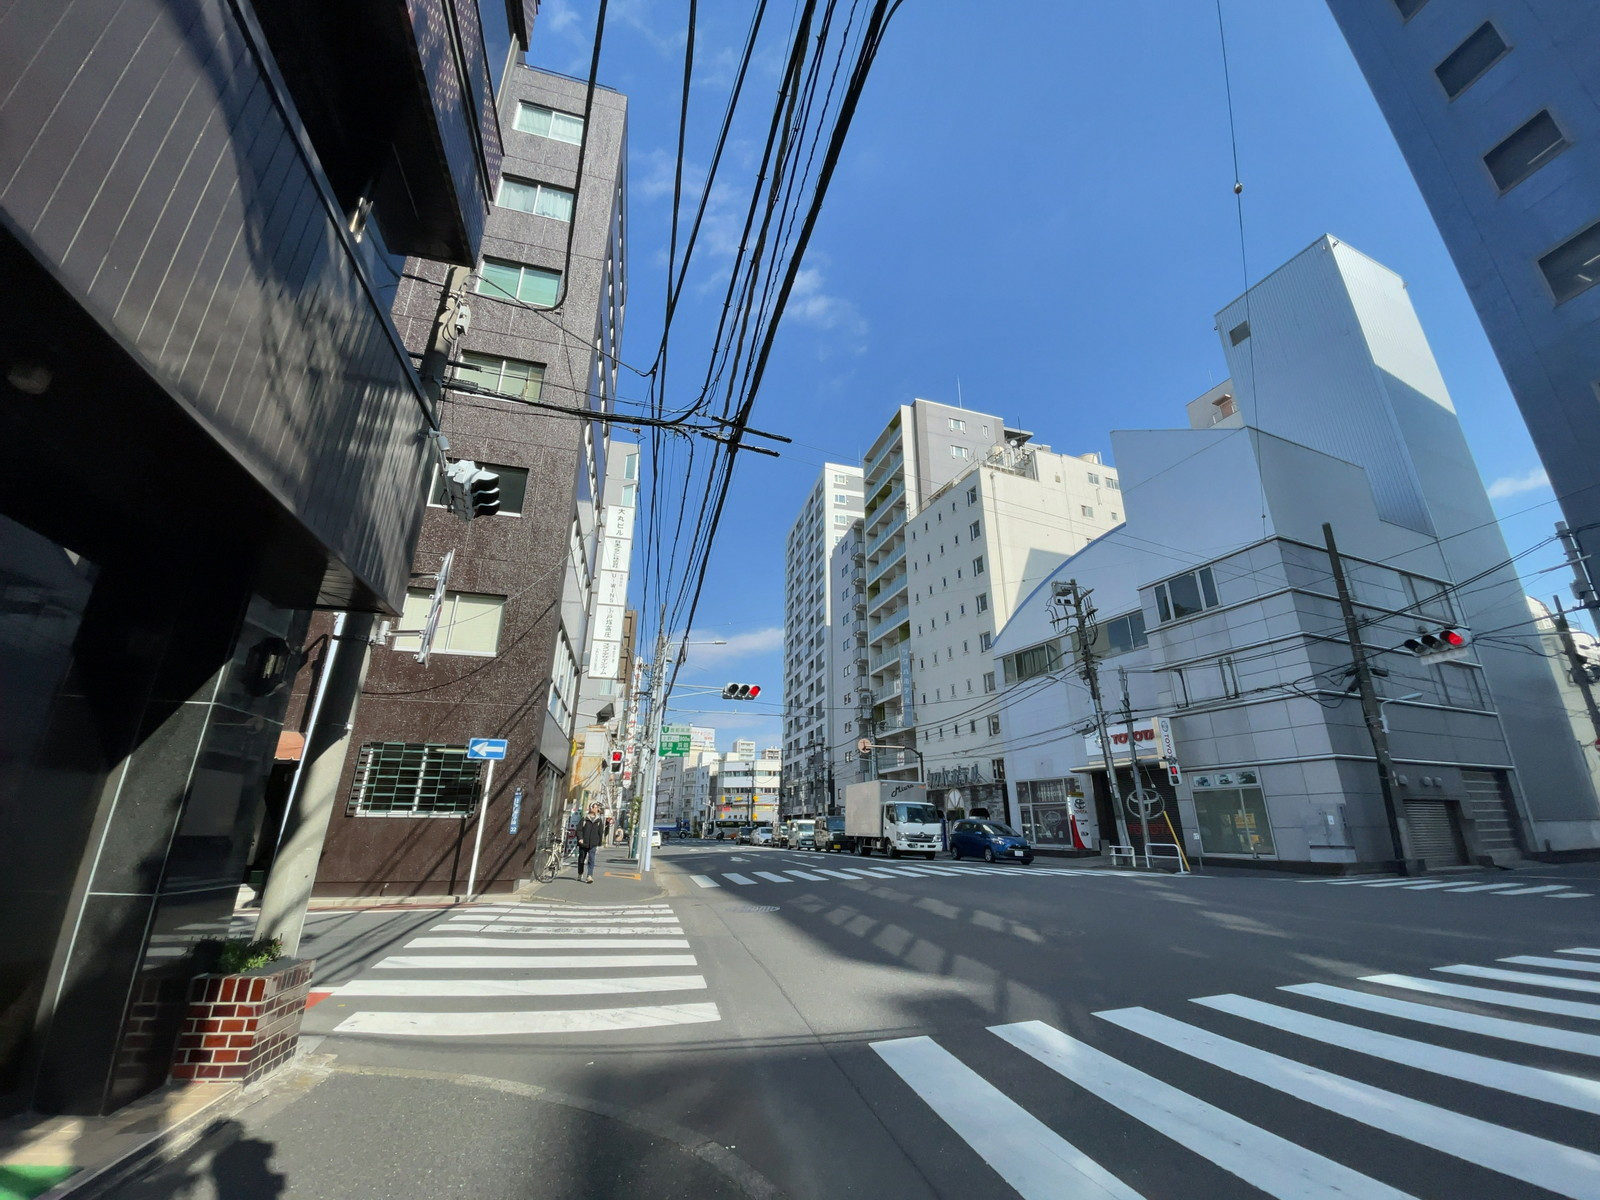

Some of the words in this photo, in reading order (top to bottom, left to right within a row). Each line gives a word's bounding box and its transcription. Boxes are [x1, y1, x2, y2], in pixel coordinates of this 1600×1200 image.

[616, 508, 626, 536] 大丸ビル
[1111, 729, 1155, 745] TOOTA
